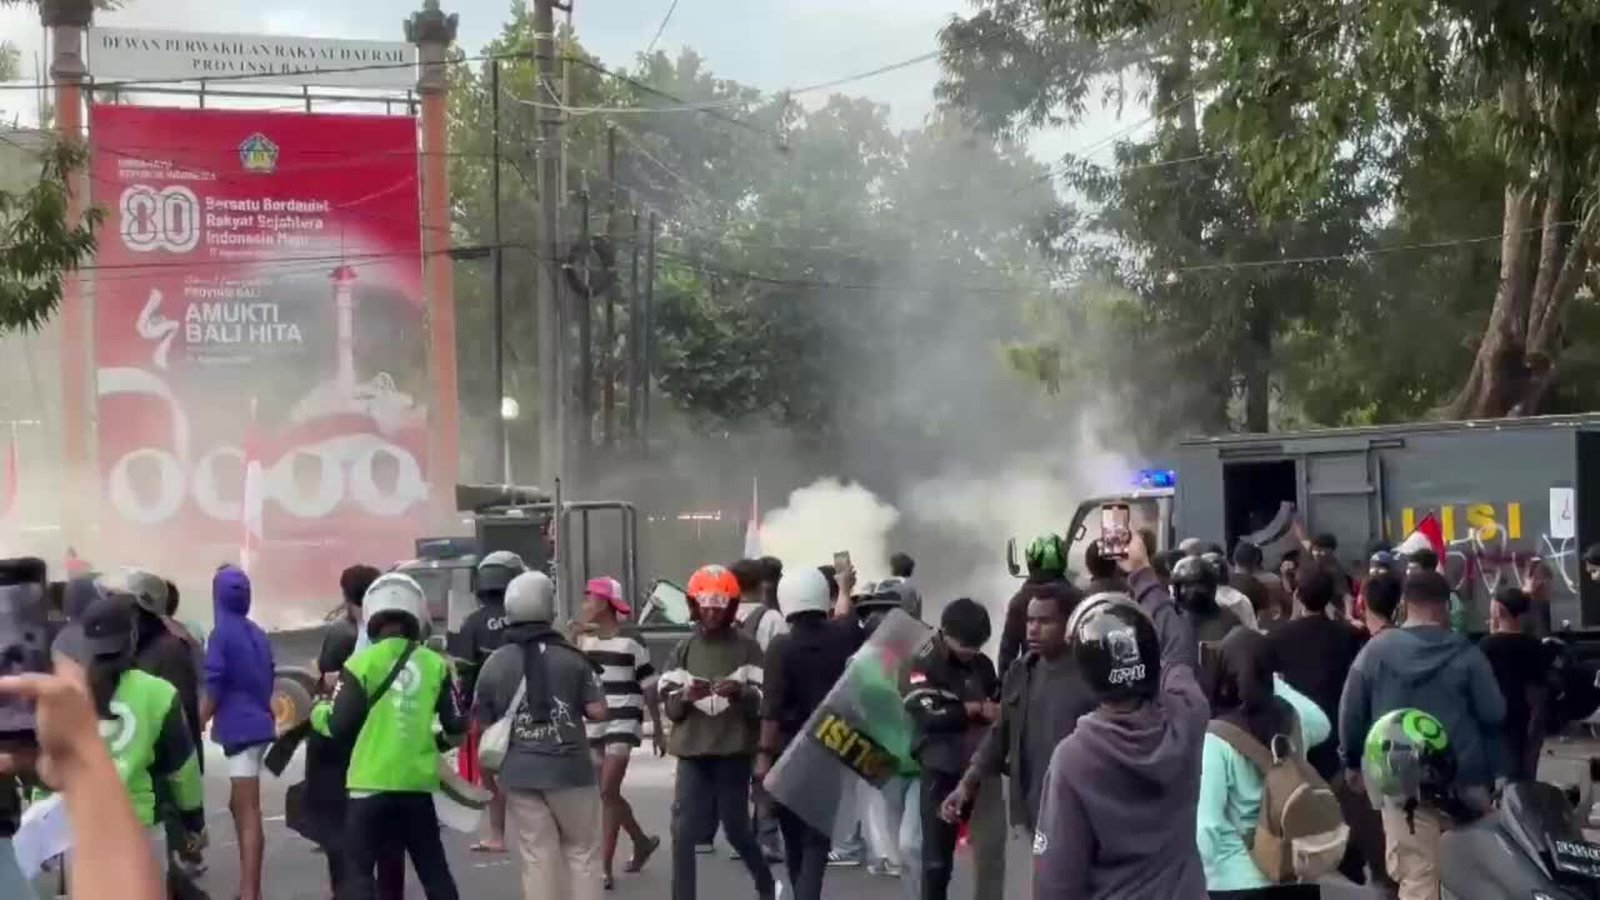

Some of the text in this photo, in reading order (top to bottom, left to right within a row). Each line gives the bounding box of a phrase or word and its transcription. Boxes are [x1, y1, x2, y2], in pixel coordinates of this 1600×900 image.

[102, 36, 404, 62] DEWAN PERWAKILAN RAKYAT DAERAH
[193, 58, 275, 73] PROVINSI
[205, 196, 261, 212] Bersatu
[120, 184, 200, 252] 80
[206, 213, 254, 231] Rakyat
[206, 230, 275, 246] Indonesia
[185, 301, 279, 323] AMUKTI
[186, 322, 303, 344] BALI HITA
